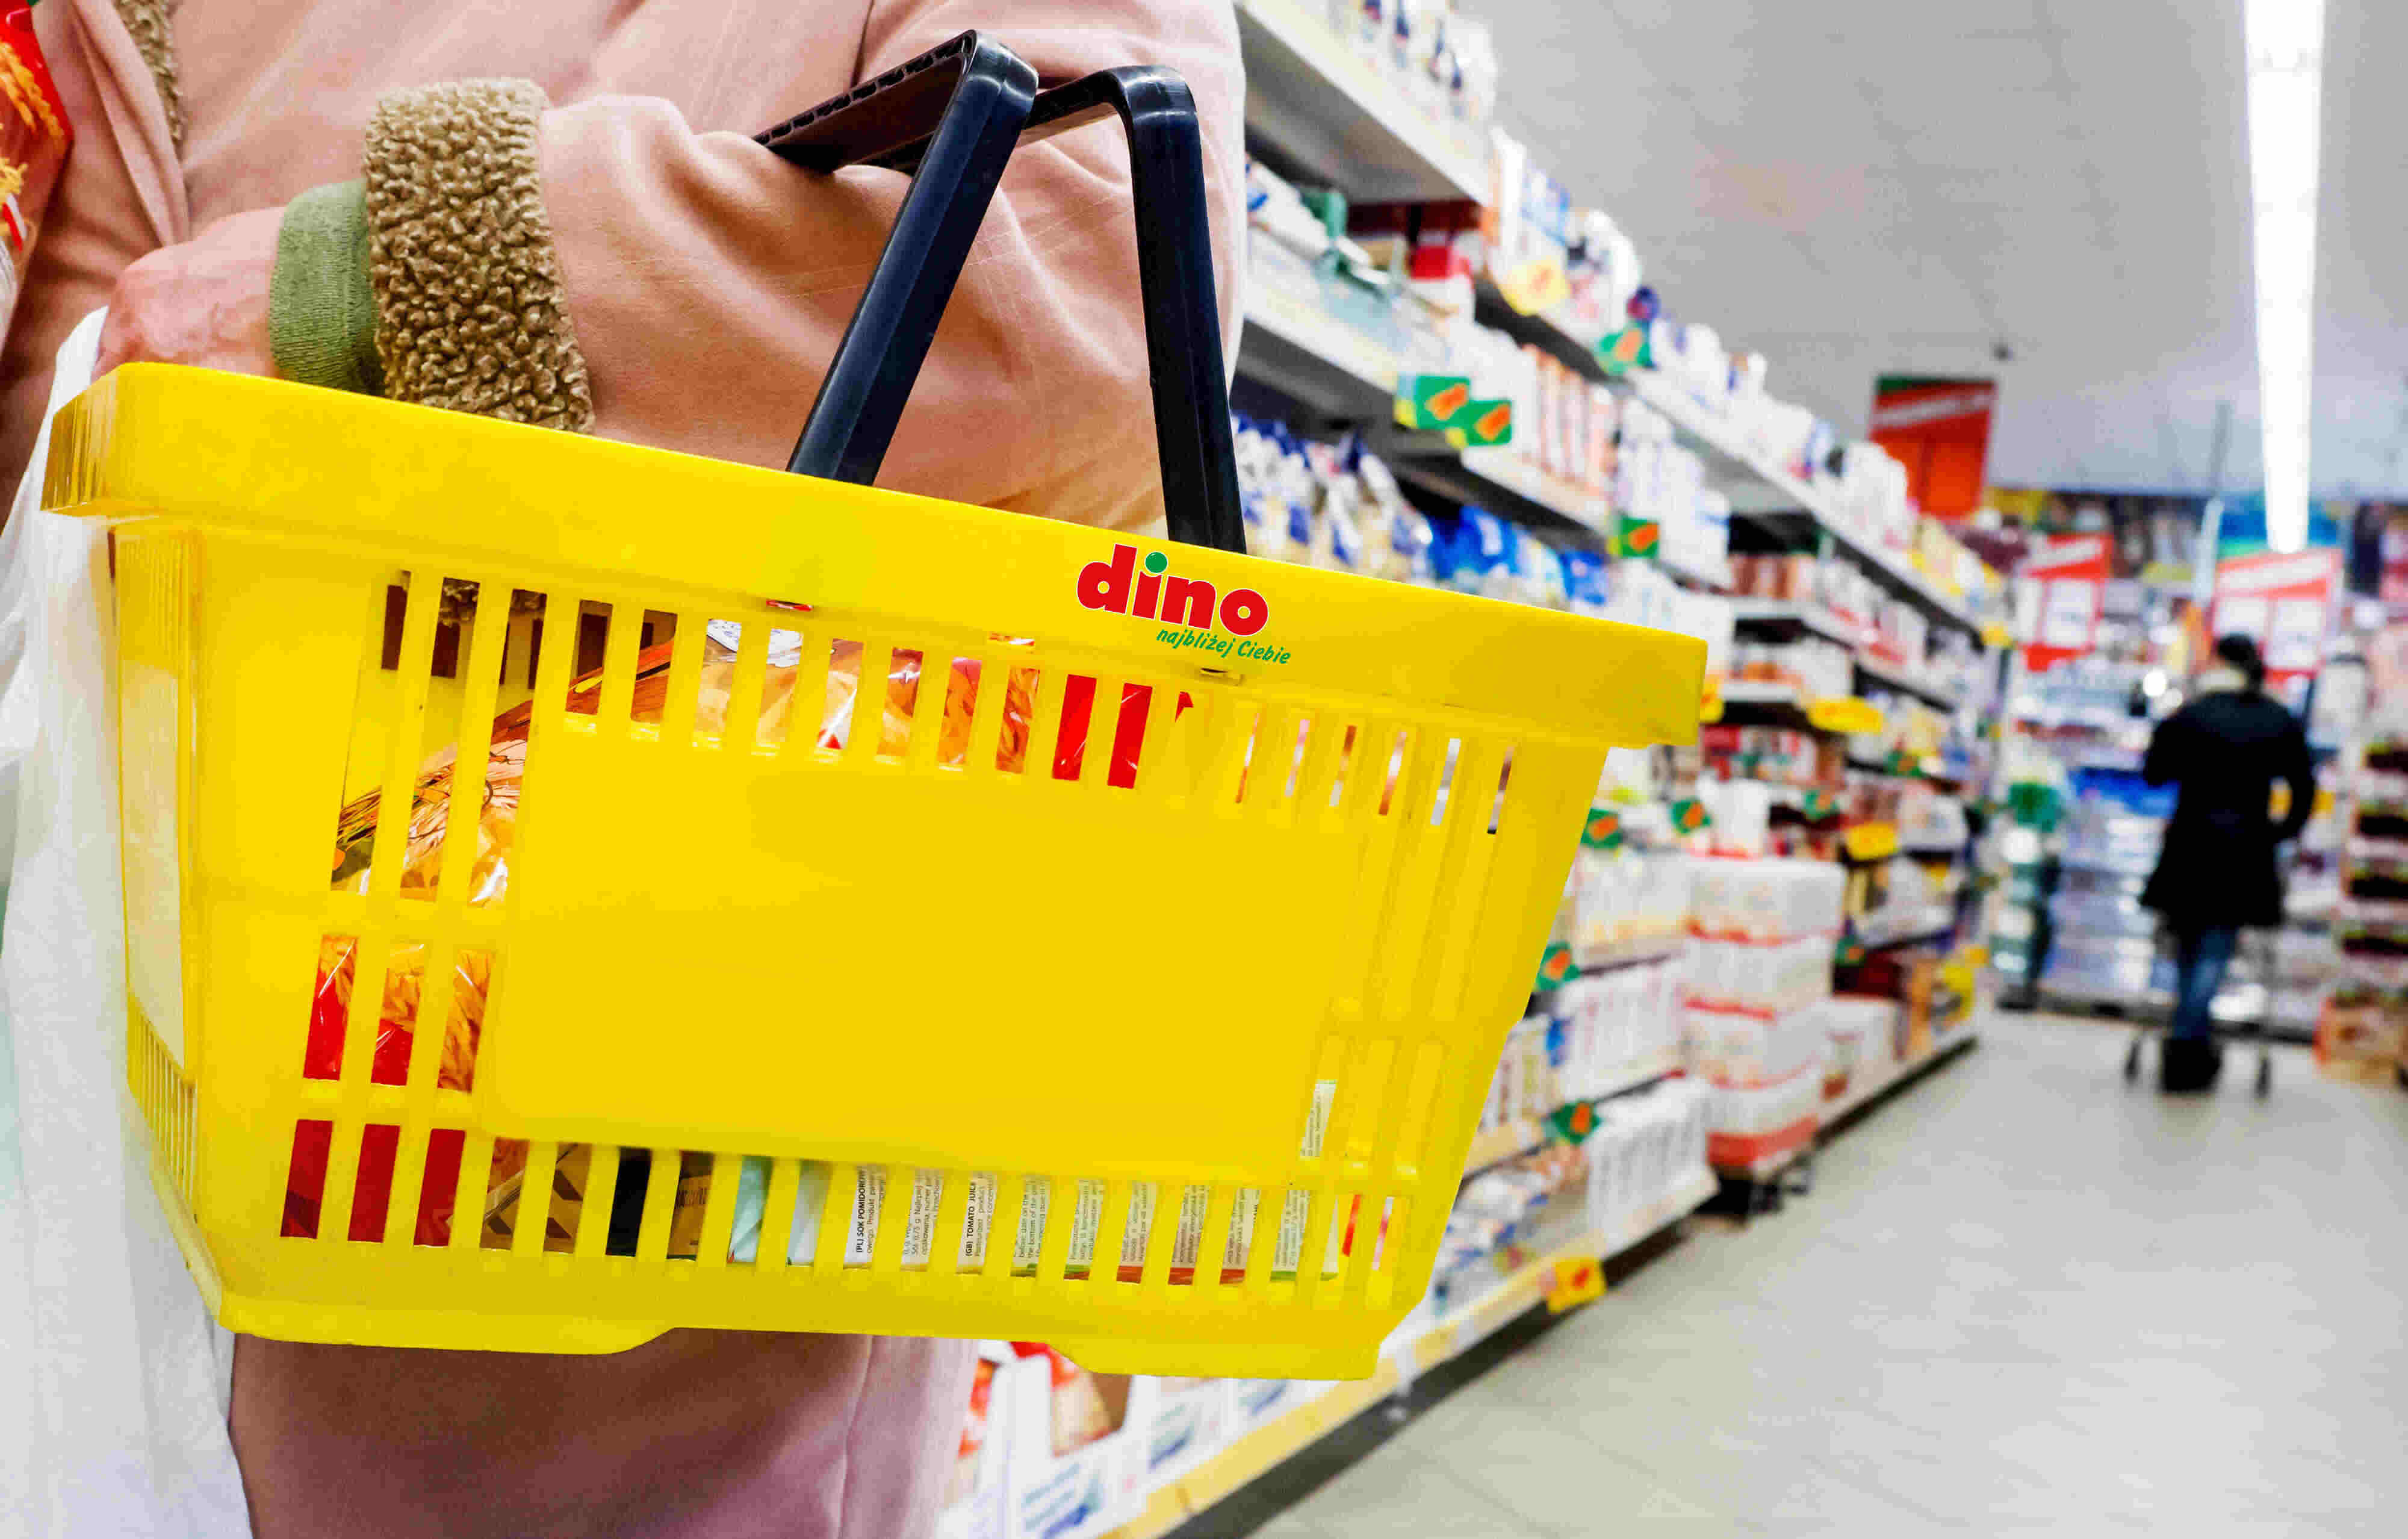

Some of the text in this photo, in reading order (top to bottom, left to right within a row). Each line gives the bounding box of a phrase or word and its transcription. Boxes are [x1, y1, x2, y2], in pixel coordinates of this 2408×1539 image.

[1077, 544, 1268, 636] dino
[1156, 629, 1291, 664] najbliżej Ciebie
[857, 1221, 865, 1237] SOK
[966, 1206, 975, 1238] TOMATO
[965, 1241, 973, 1257] (GB)
